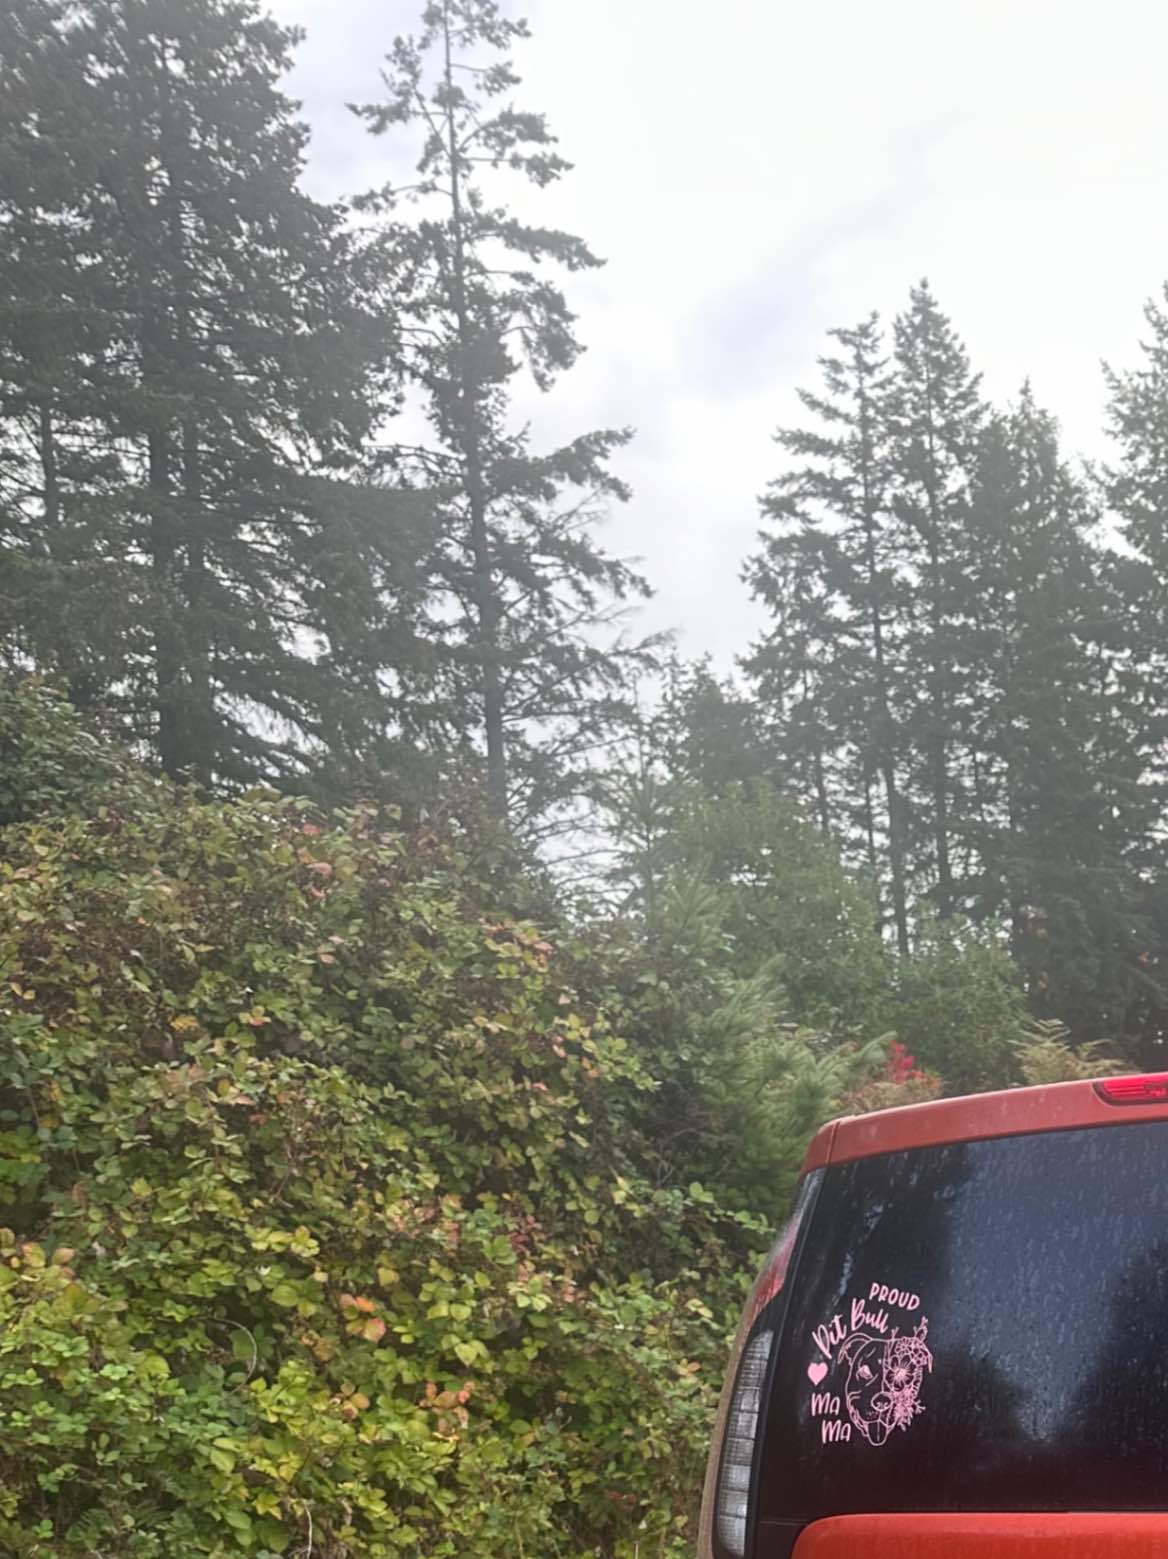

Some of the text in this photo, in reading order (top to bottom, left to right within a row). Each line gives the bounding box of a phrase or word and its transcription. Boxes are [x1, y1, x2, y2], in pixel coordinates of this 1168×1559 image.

[869, 1282, 920, 1310] PROUD
[812, 1298, 889, 1359] Pit Bull
